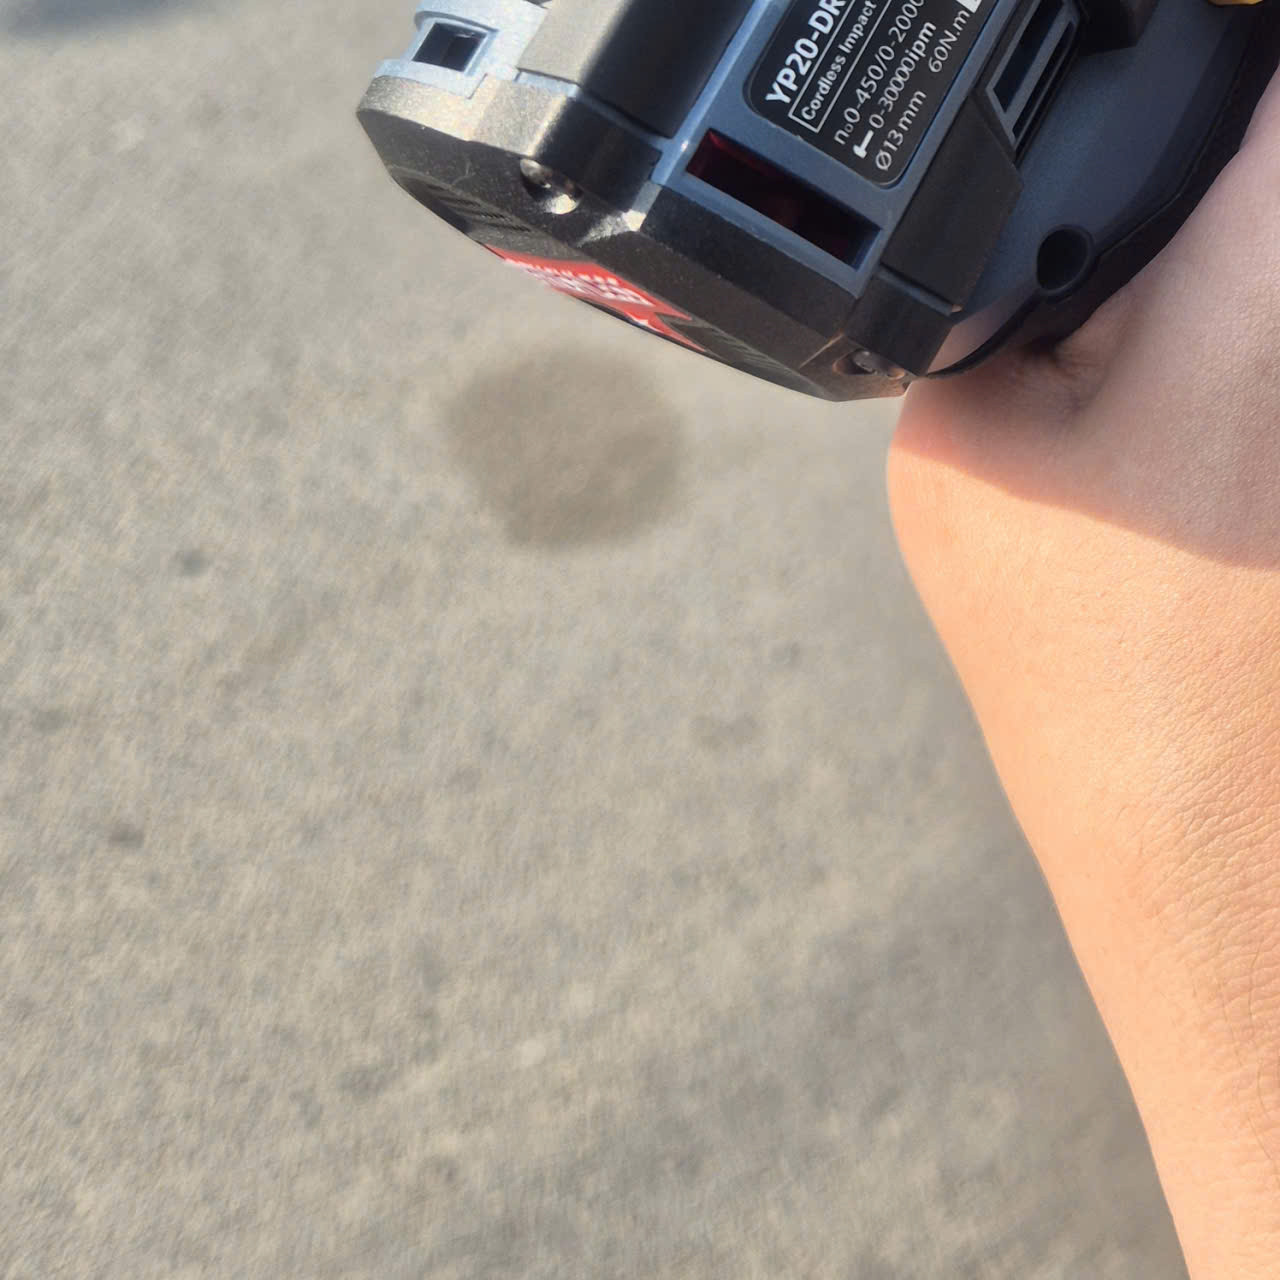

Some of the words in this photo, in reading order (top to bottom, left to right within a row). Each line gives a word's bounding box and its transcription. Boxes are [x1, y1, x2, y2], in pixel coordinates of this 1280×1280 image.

[801, 54, 847, 121] Cordless
[837, 0, 878, 54] Impact
[928, 8, 971, 74] 60N.m
